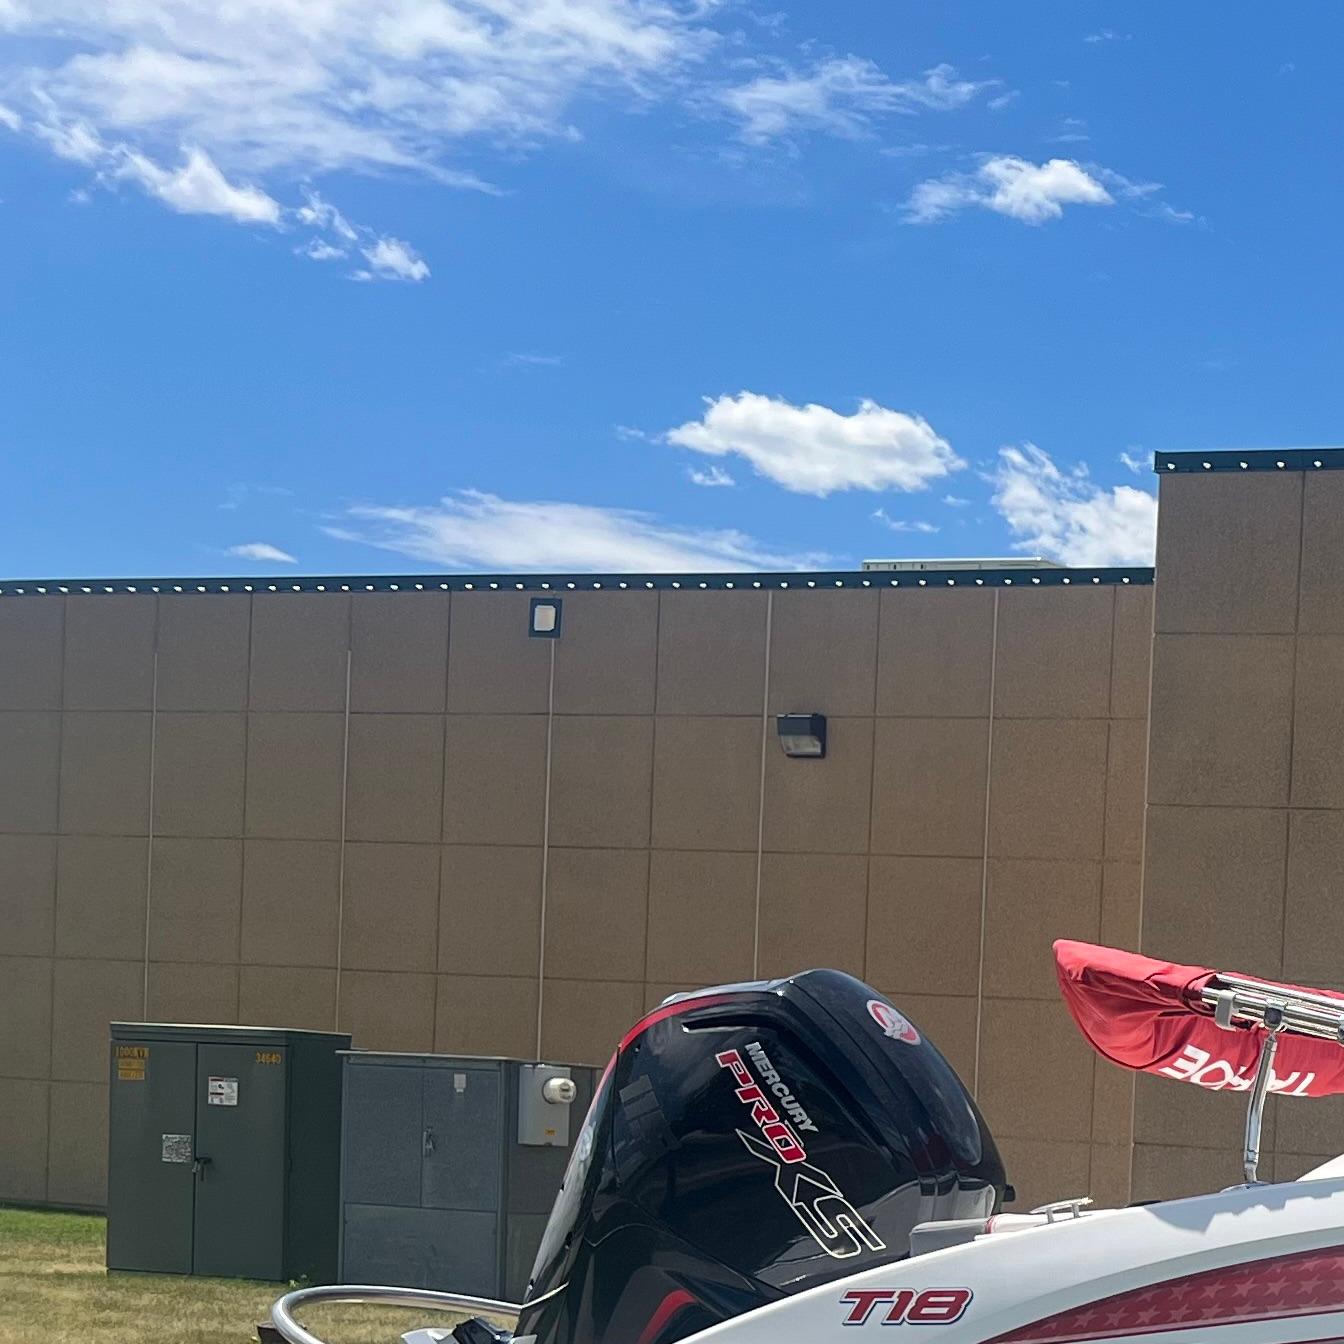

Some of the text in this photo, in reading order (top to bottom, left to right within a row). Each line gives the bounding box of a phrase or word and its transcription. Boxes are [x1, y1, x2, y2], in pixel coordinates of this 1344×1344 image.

[745, 1041, 819, 1133] MERCURY
[715, 1049, 887, 1259] PRO XS
[839, 1287, 974, 1327] T18
